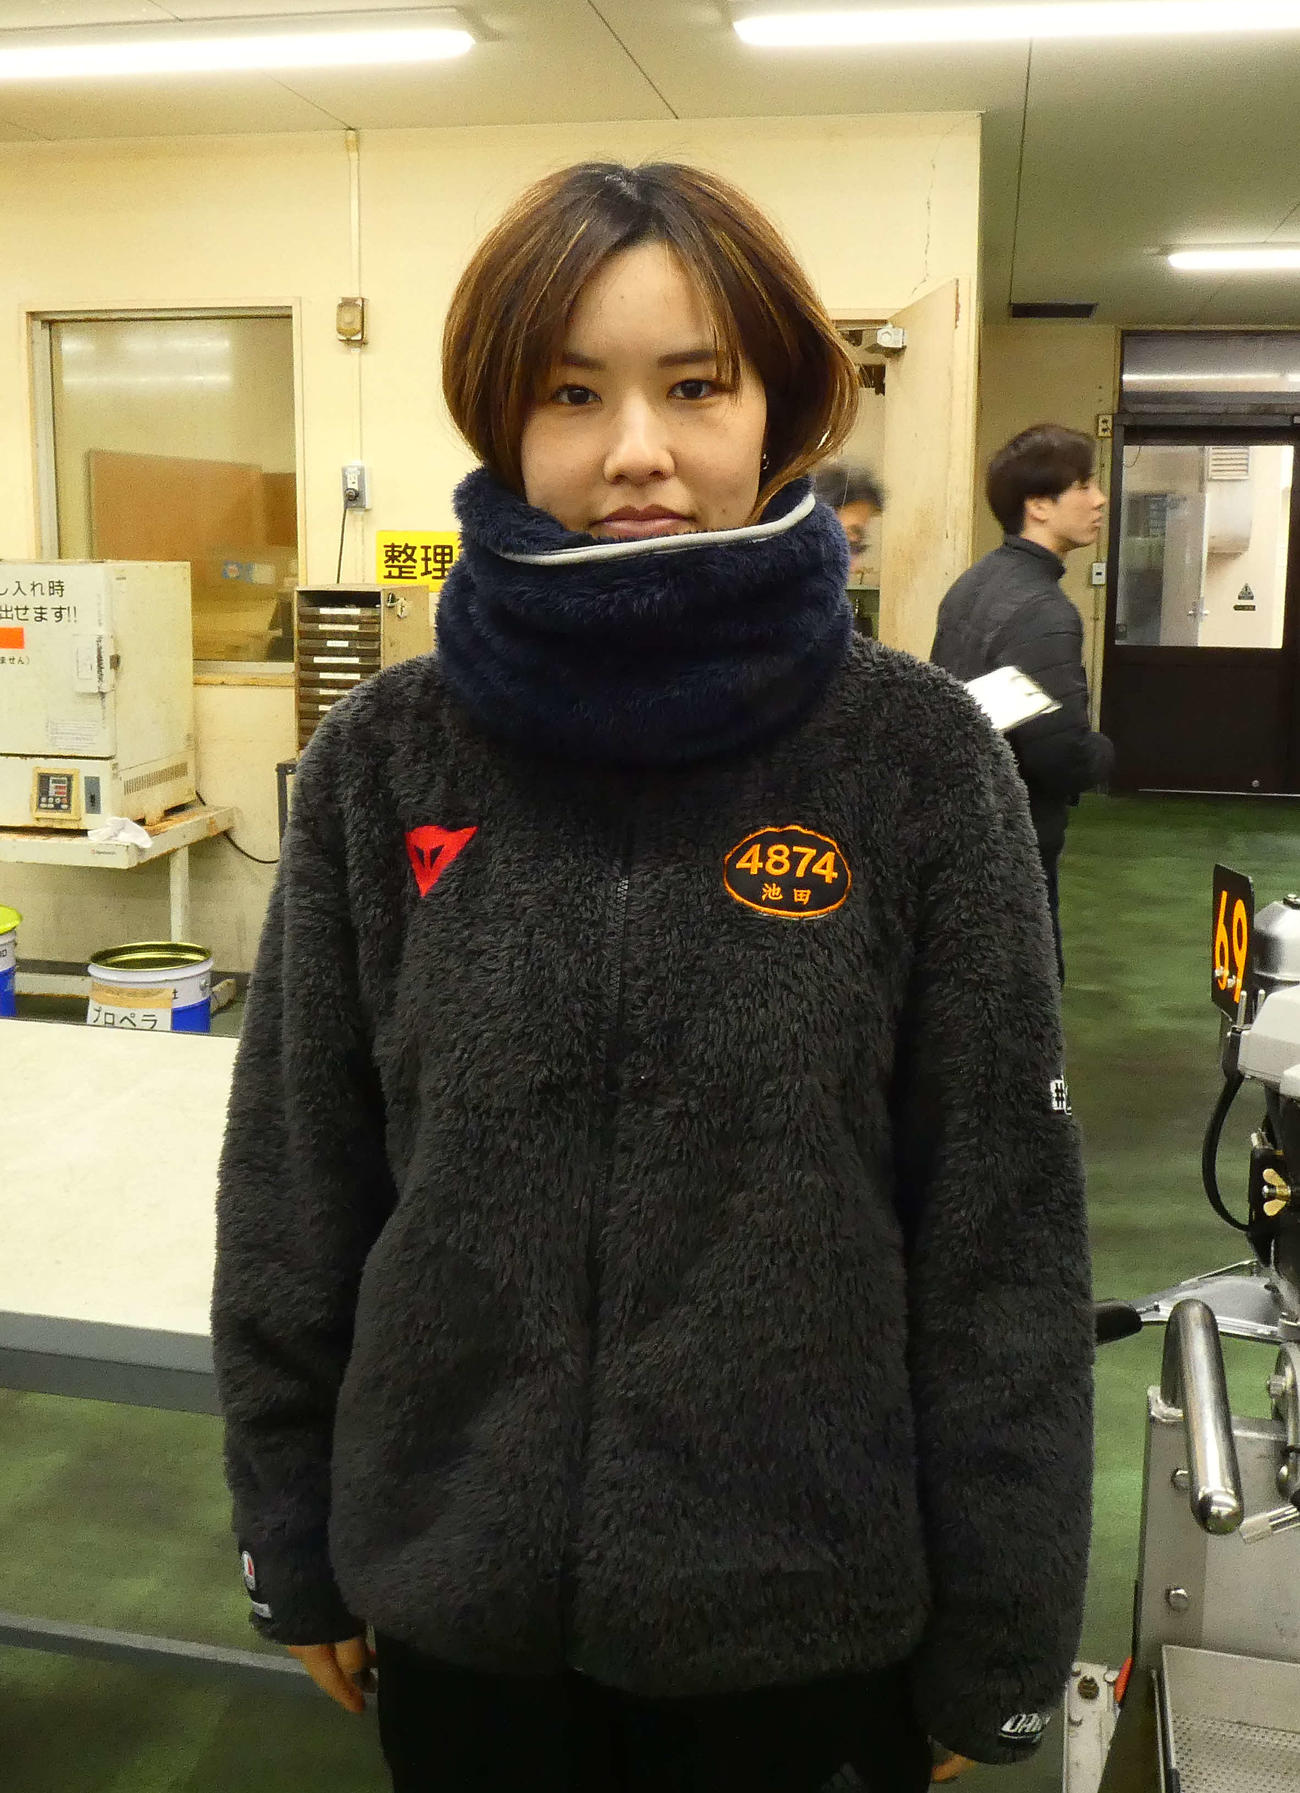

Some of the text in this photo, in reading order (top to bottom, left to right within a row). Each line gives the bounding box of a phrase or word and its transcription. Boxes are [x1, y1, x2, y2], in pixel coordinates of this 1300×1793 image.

[735, 843, 838, 884] 4874
[761, 882, 812, 906] 池田
[1215, 890, 1248, 1004] 69
[92, 1006, 158, 1029] プロペラ
